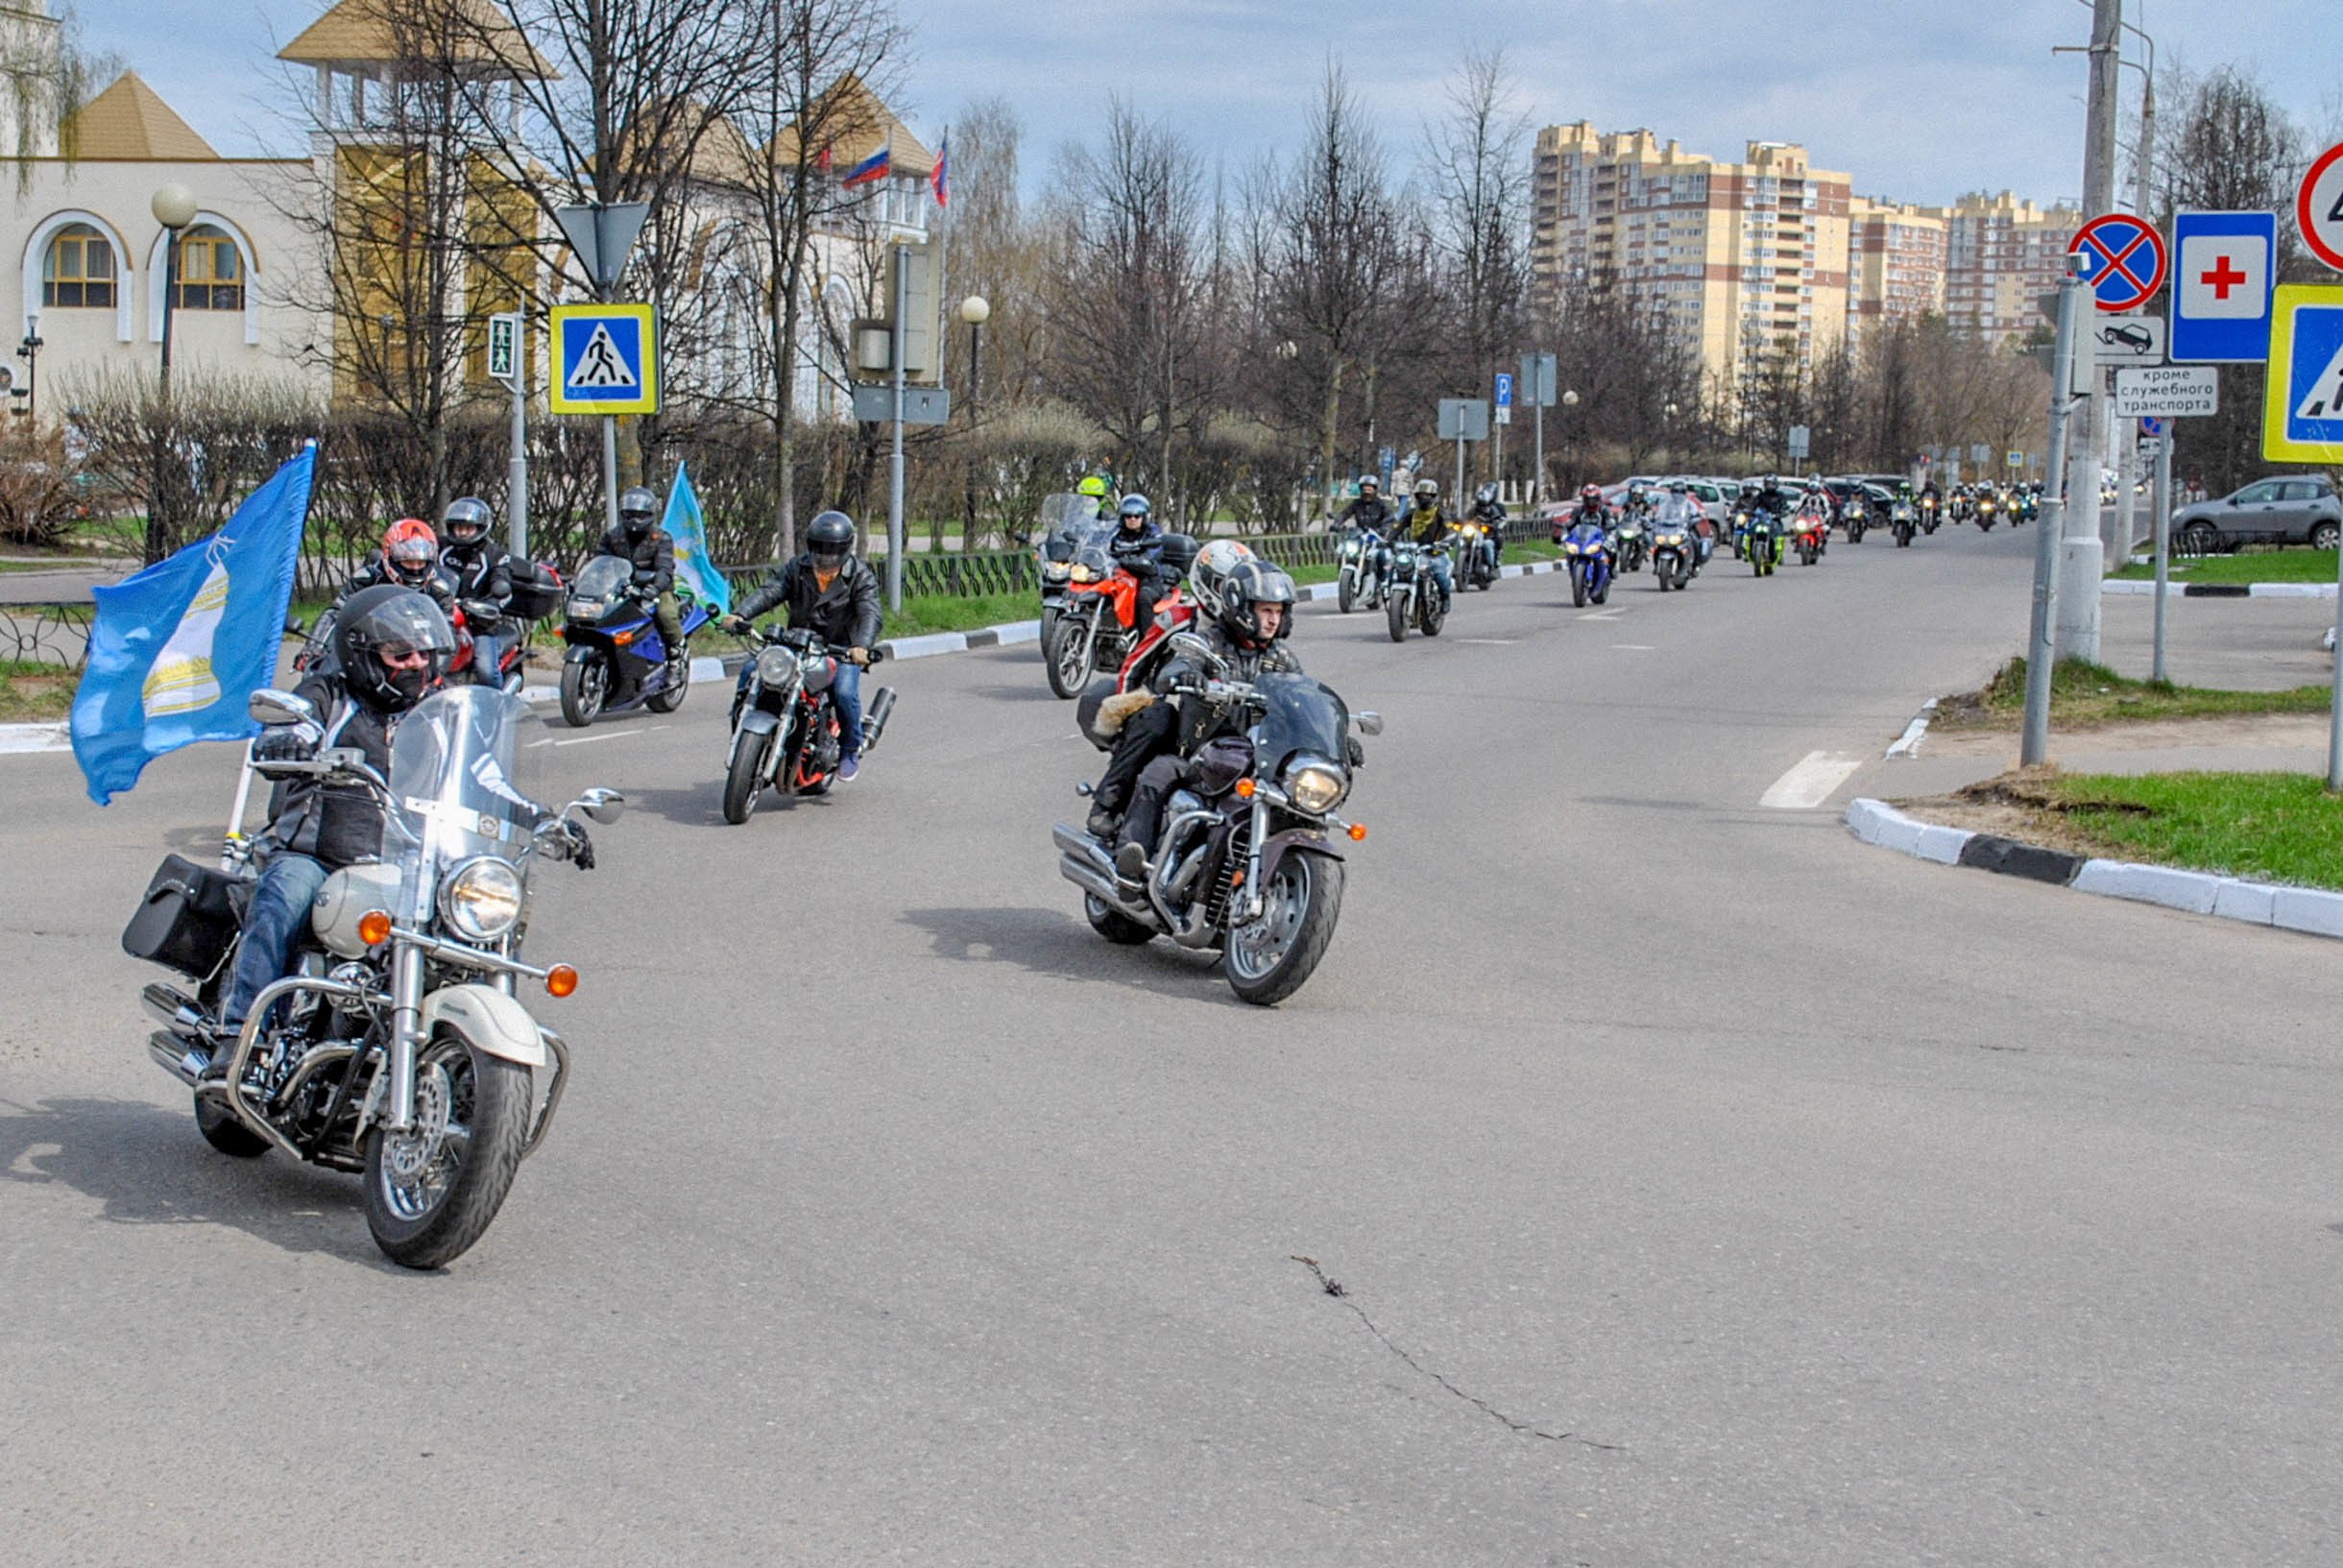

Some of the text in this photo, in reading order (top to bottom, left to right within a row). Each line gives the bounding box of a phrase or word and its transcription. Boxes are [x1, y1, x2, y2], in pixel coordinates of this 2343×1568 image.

[2143, 371, 2190, 382] кроме
[1499, 378, 1509, 402] P
[2121, 383, 2213, 398] служебного
[2124, 399, 2210, 412] транспорта
